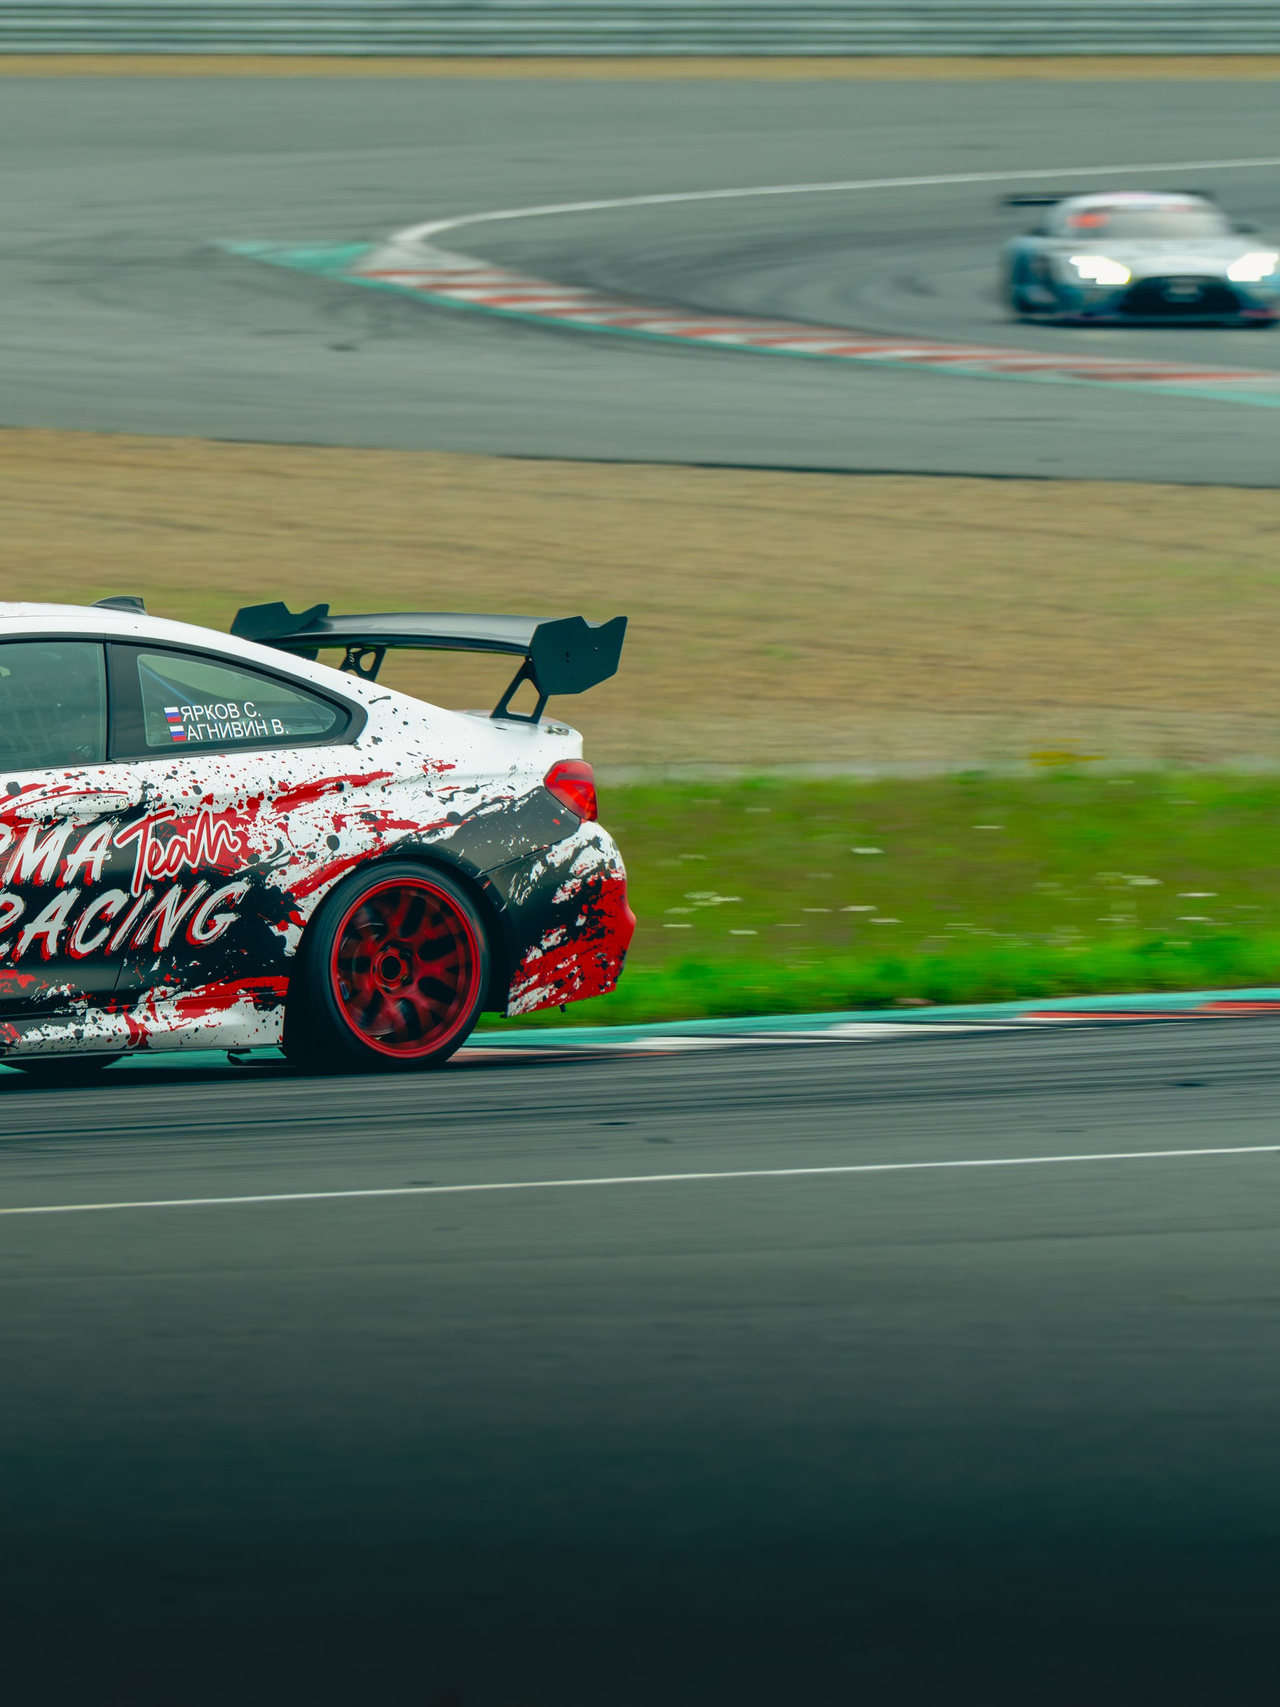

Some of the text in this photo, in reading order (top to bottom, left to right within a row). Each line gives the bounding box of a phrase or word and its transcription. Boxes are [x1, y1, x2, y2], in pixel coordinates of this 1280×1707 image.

[180, 701, 261, 722] ЯРКОВ С.
[187, 718, 289, 741] АГНИВИН В.
[114, 805, 241, 897] Team
